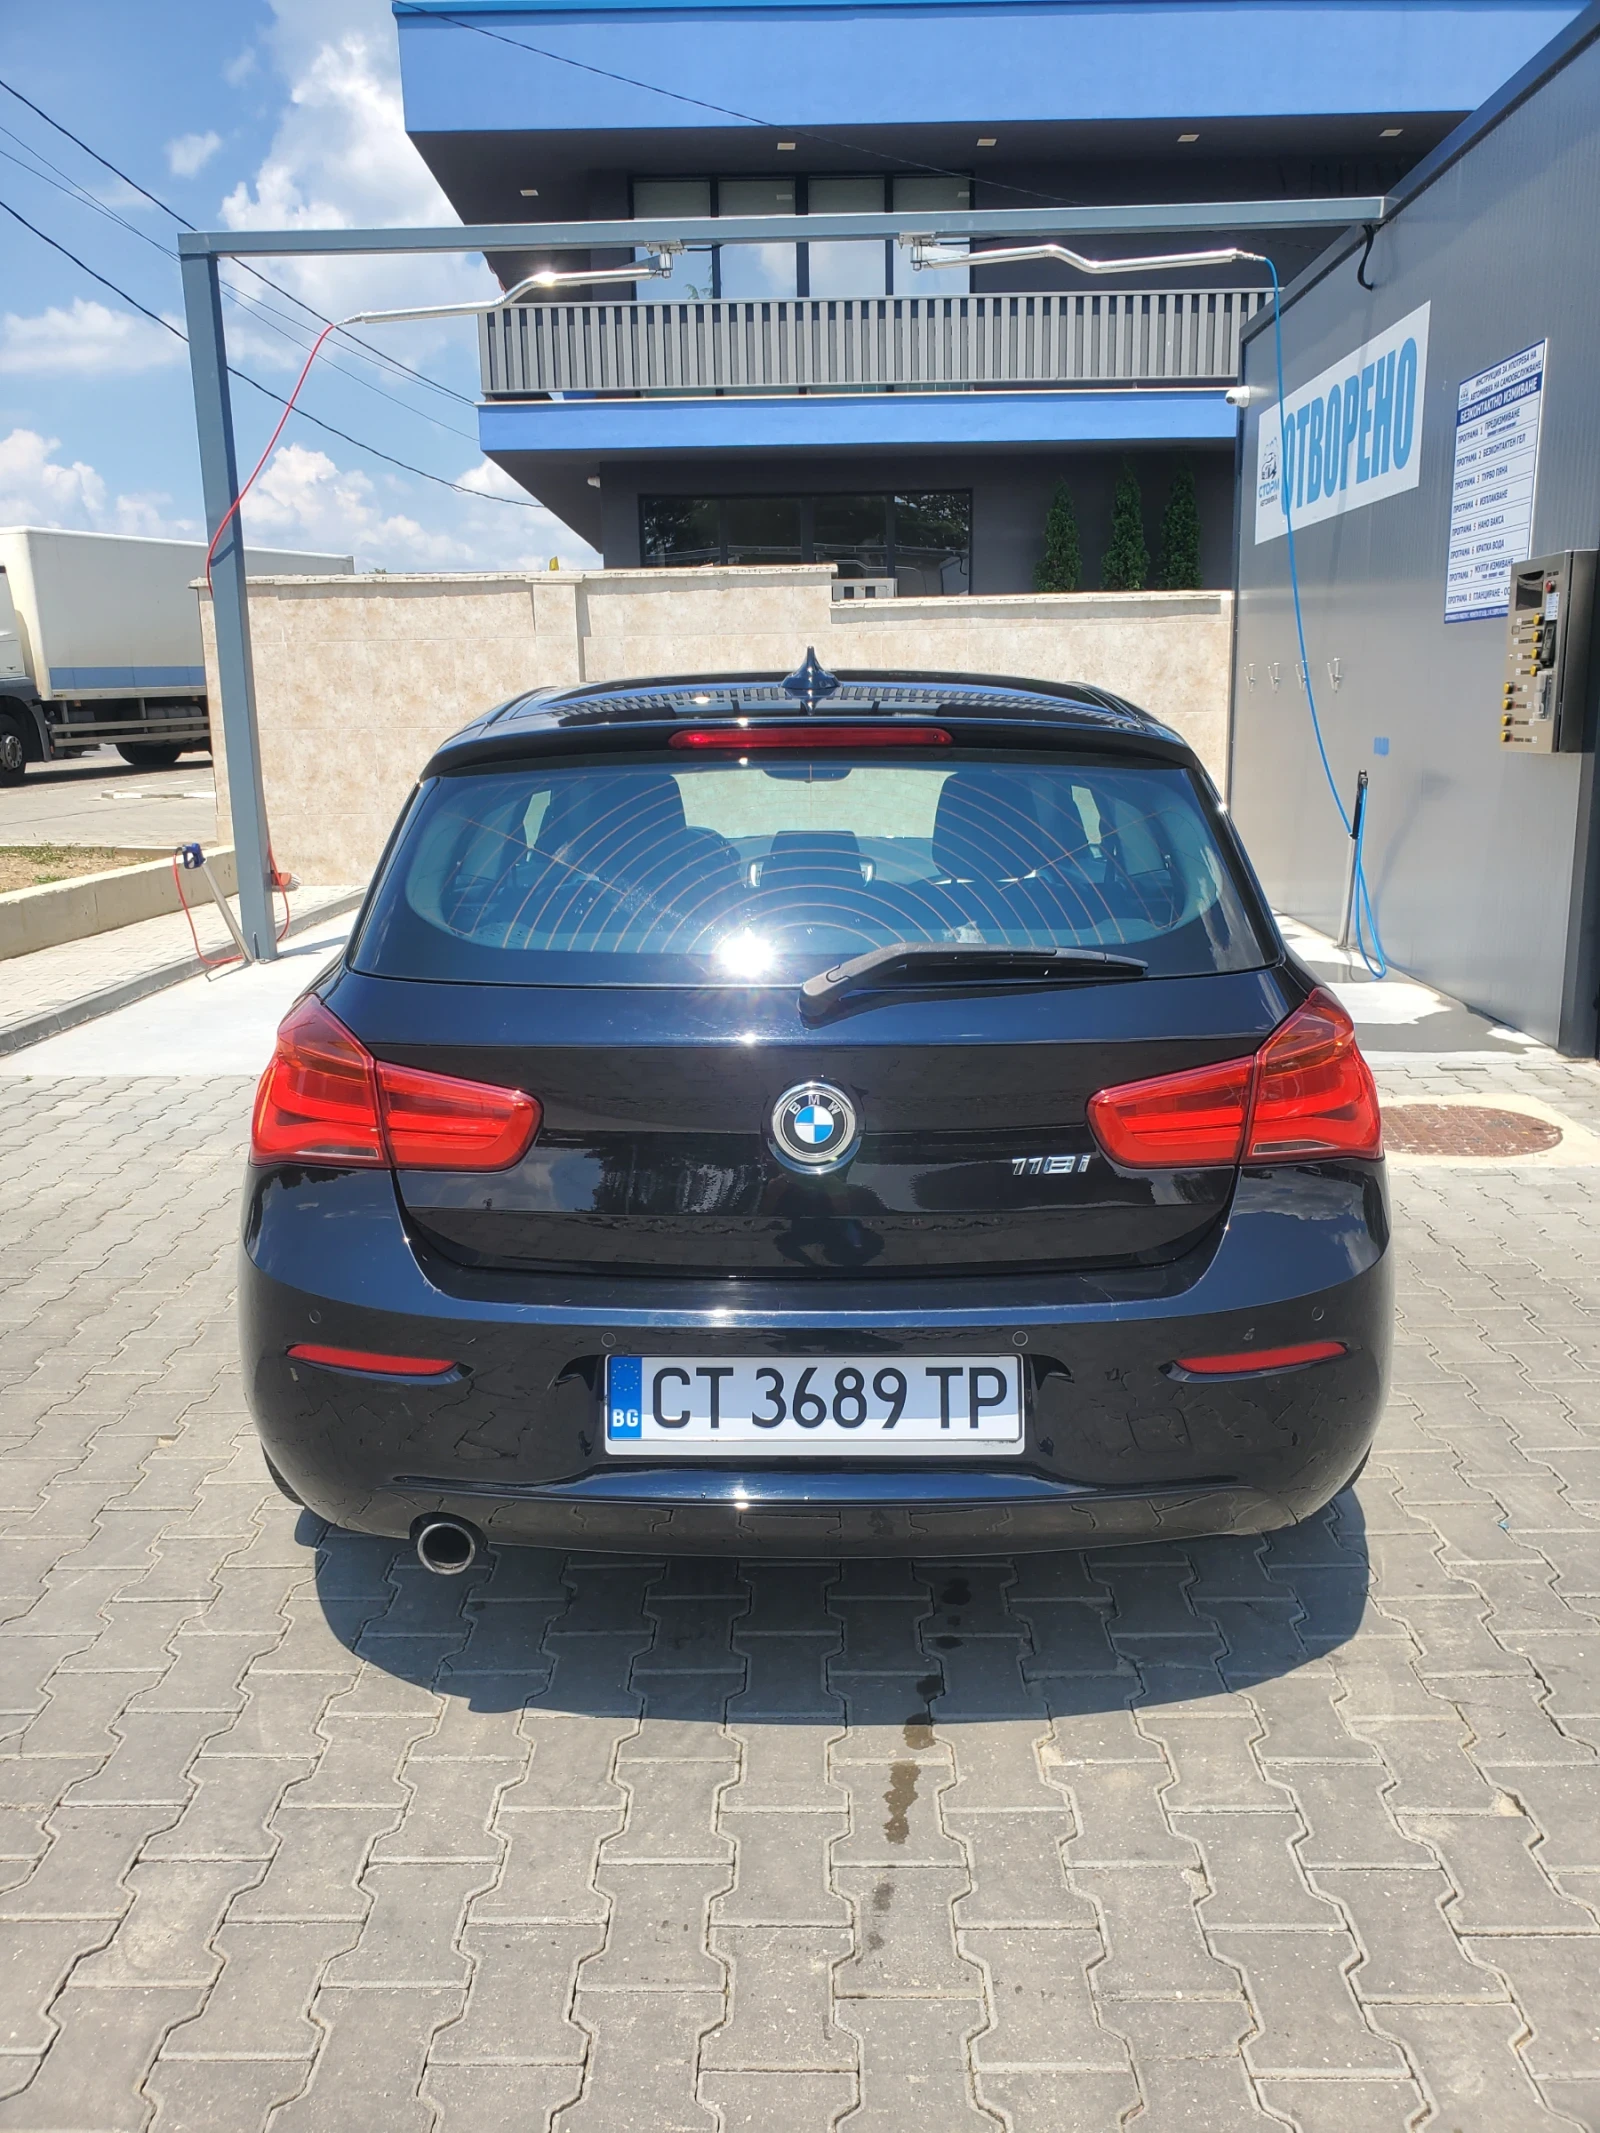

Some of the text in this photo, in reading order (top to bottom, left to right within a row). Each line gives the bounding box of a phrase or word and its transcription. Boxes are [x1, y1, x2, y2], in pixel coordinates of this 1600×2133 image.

[1530, 349, 1537, 360] НА
[1503, 376, 1538, 405] ИЗМИВАНЕ
[1281, 337, 1417, 516] ОТВОРЕНО
[1457, 429, 1478, 444] ПРОГРАМА
[1456, 453, 1477, 467] ПРОГРАМА
[1259, 478, 1280, 498] СТОРМ
[1455, 477, 1475, 491] ПРОГРАМА
[1481, 470, 1495, 481] ТУРБО
[1453, 501, 1474, 514] ПРОГРАМА
[1479, 489, 1508, 506] ИЗПЛАКВАНЕ
[1452, 524, 1471, 536] ПРОГРАМА
[1477, 518, 1490, 530] НАНО
[1490, 514, 1504, 526] ВАКСА
[1450, 548, 1470, 559] ПРОГРАМА
[1476, 543, 1492, 553] КРАТКА
[1492, 539, 1505, 550] ВОДА
[1449, 571, 1469, 582] ПРОГРАМА
[1474, 562, 1489, 573] МУЛТИ
[1448, 594, 1467, 604] ПРОГРАМА
[1473, 588, 1500, 600] ГЛАНЦИРАНЕ
[788, 1094, 841, 1115] BMW
[1012, 1155, 1091, 1176] 118i
[652, 1366, 1007, 1429] CT 3689 TP
[611, 1409, 639, 1428] BG
